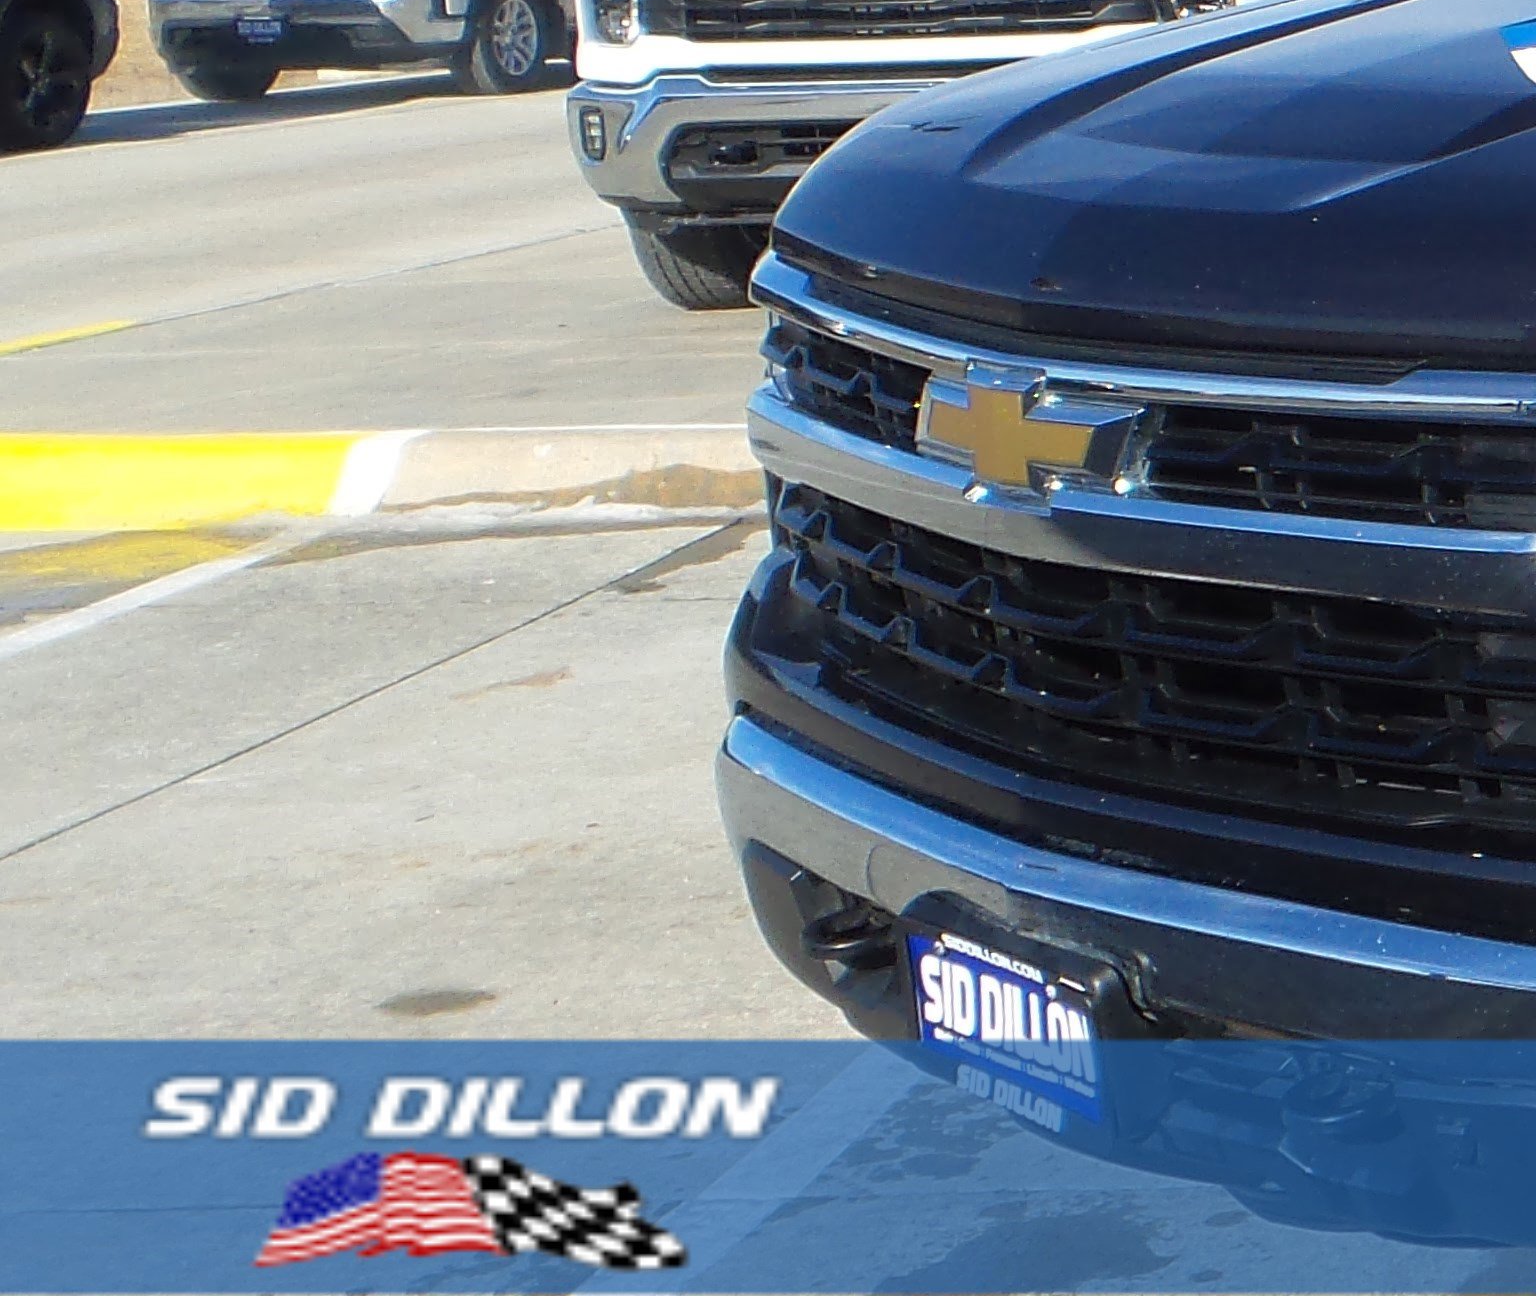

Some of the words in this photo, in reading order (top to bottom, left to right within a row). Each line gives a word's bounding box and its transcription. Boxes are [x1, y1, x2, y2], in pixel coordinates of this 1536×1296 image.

[920, 955, 975, 1037] SID
[980, 973, 1097, 1083] DILLON
[956, 1064, 990, 1099] SID
[993, 1077, 1062, 1133] DILLON
